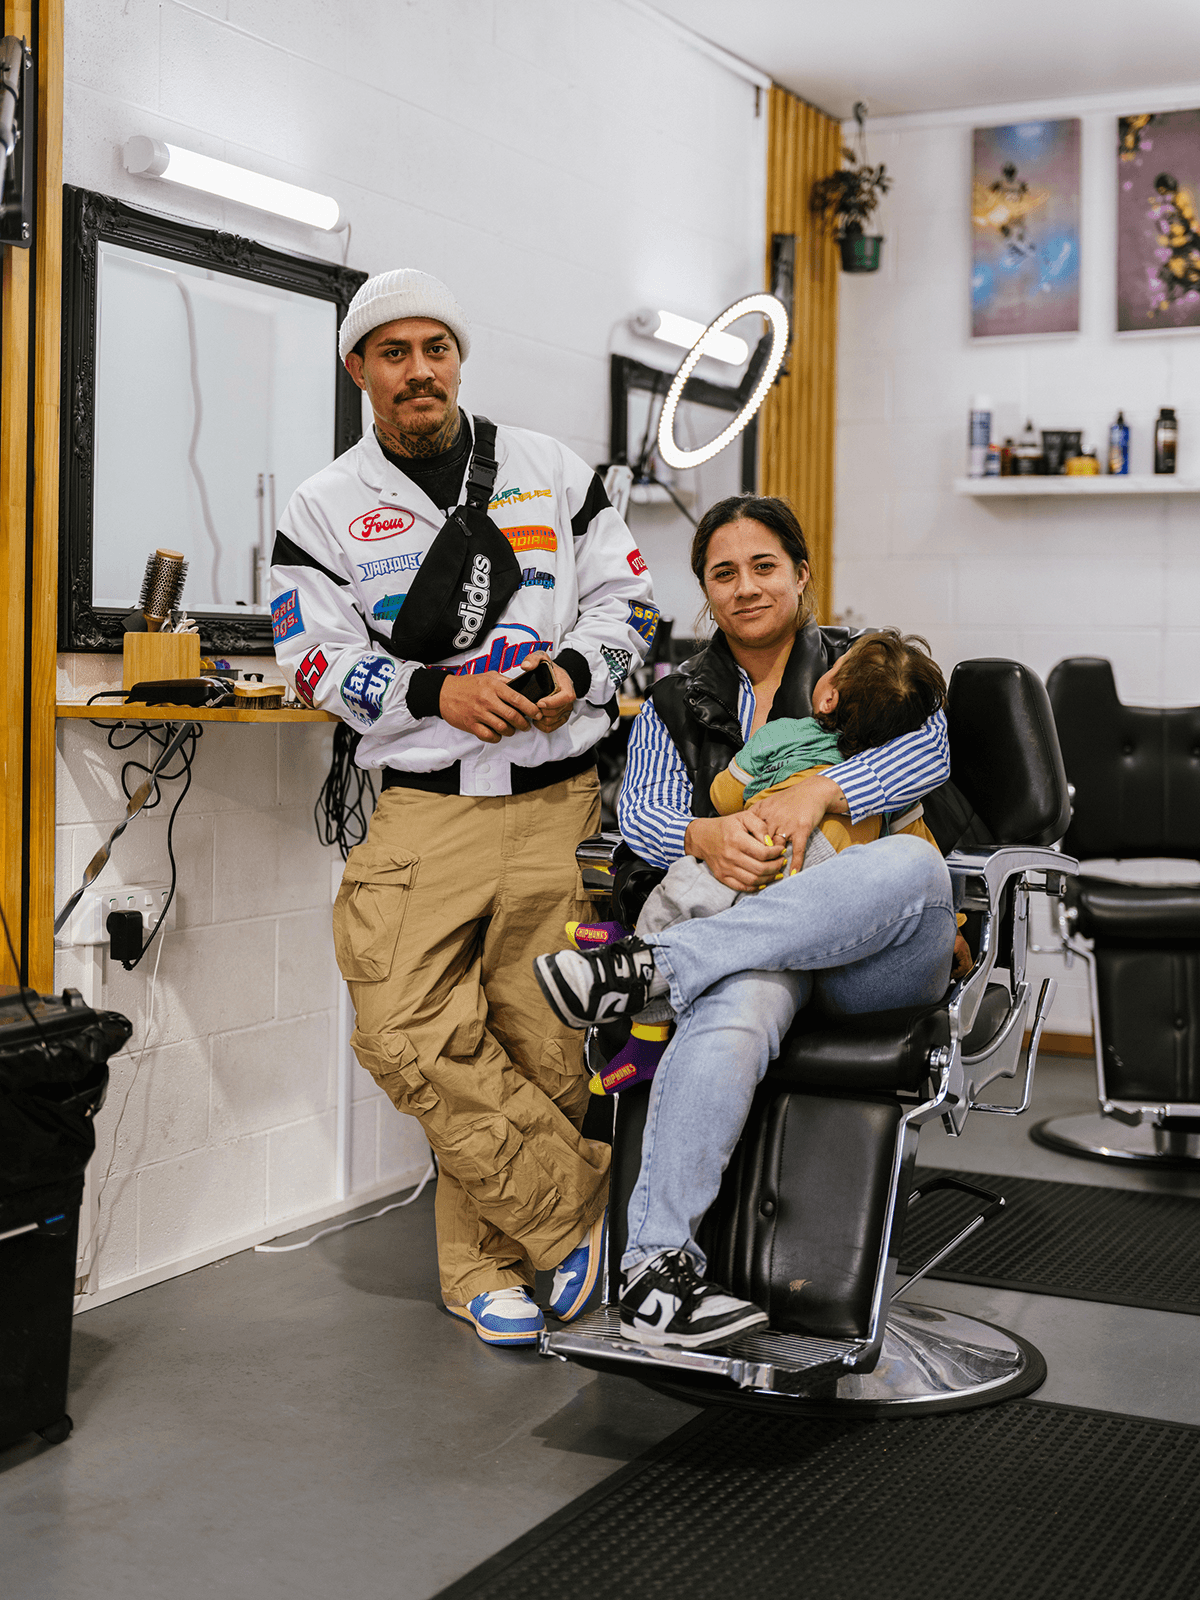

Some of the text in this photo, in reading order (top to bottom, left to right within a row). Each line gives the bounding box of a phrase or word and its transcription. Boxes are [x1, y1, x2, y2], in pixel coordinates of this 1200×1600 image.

[362, 513, 404, 538] Focus
[507, 536, 556, 547] ADIANT
[360, 552, 422, 581] VARIOUS
[631, 555, 646, 571] VIC
[271, 590, 298, 623] ead
[453, 554, 492, 649] adidas
[576, 928, 608, 940] CHIPMUNKS
[602, 1063, 636, 1088] CHIPMUNKS
